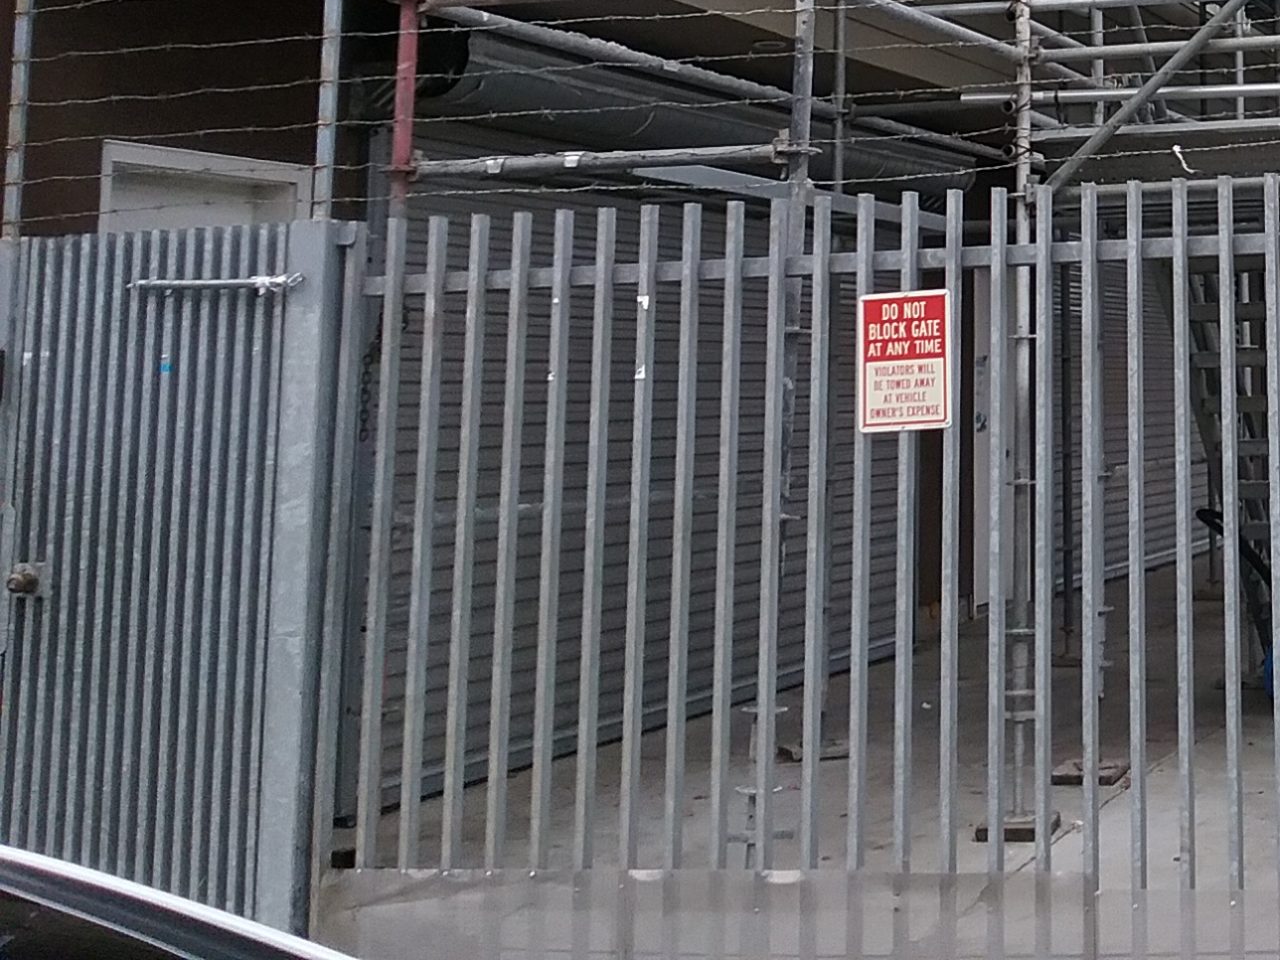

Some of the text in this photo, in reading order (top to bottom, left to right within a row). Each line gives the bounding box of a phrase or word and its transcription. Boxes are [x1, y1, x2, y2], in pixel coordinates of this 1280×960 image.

[882, 302, 926, 320] DO NOT
[869, 320, 940, 340] BLOCK GATE
[868, 339, 941, 357] AT ANY TIME
[874, 364, 935, 376] VIOLATORS WILL
[887, 379, 910, 390] TOWED
[914, 378, 936, 387] AWAY
[883, 392, 927, 403] AT VEHICLE
[870, 405, 940, 418] OWNER'S EXPENSE
